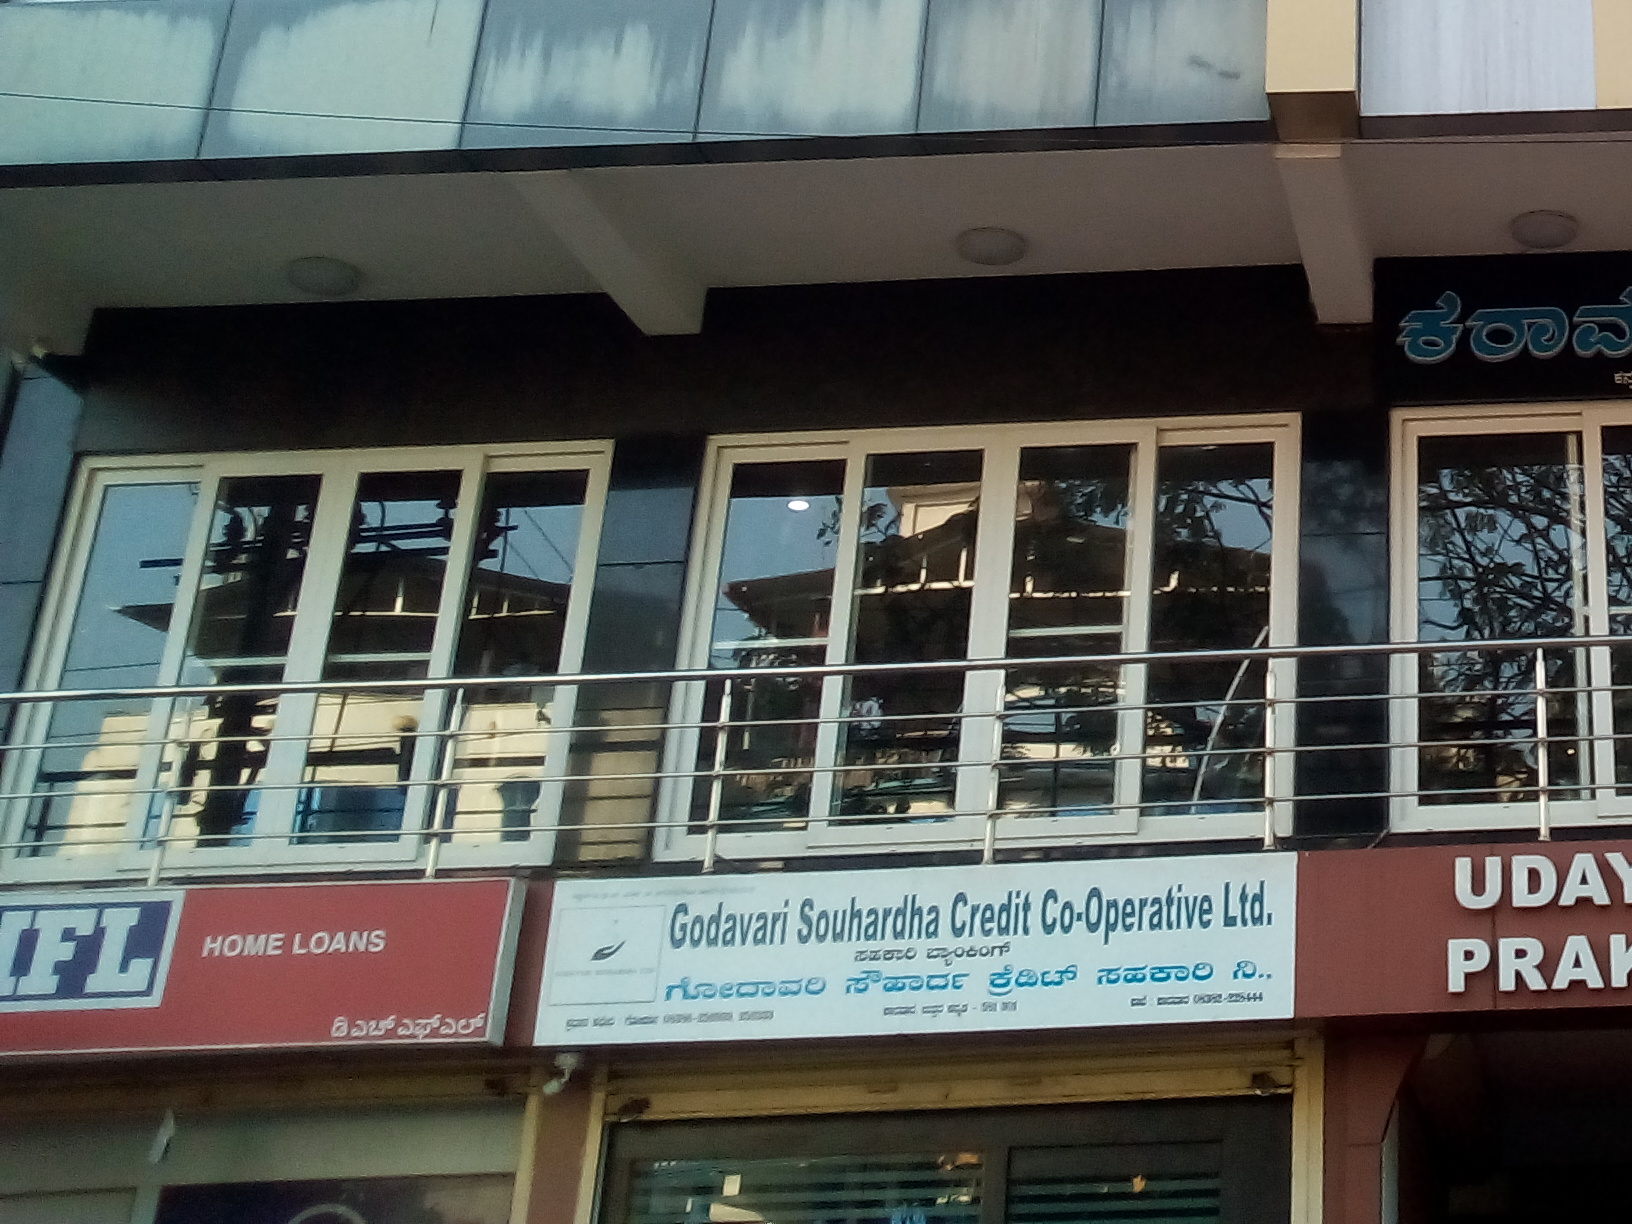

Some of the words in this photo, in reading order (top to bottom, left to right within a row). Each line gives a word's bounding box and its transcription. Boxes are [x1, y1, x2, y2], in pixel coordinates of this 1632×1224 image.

[669, 898, 790, 950] Godavari
[797, 893, 940, 945] Souhardha
[951, 889, 1031, 938] Credit
[1041, 883, 1213, 946] Co-Operative
[1223, 880, 1273, 928] Ltd.
[201, 933, 285, 957] HOME
[291, 929, 387, 954] LOANS
[664, 976, 827, 1002] ಗೋದಾವರಿ
[1096, 962, 1214, 986] ಸಹಕಾರಿ
